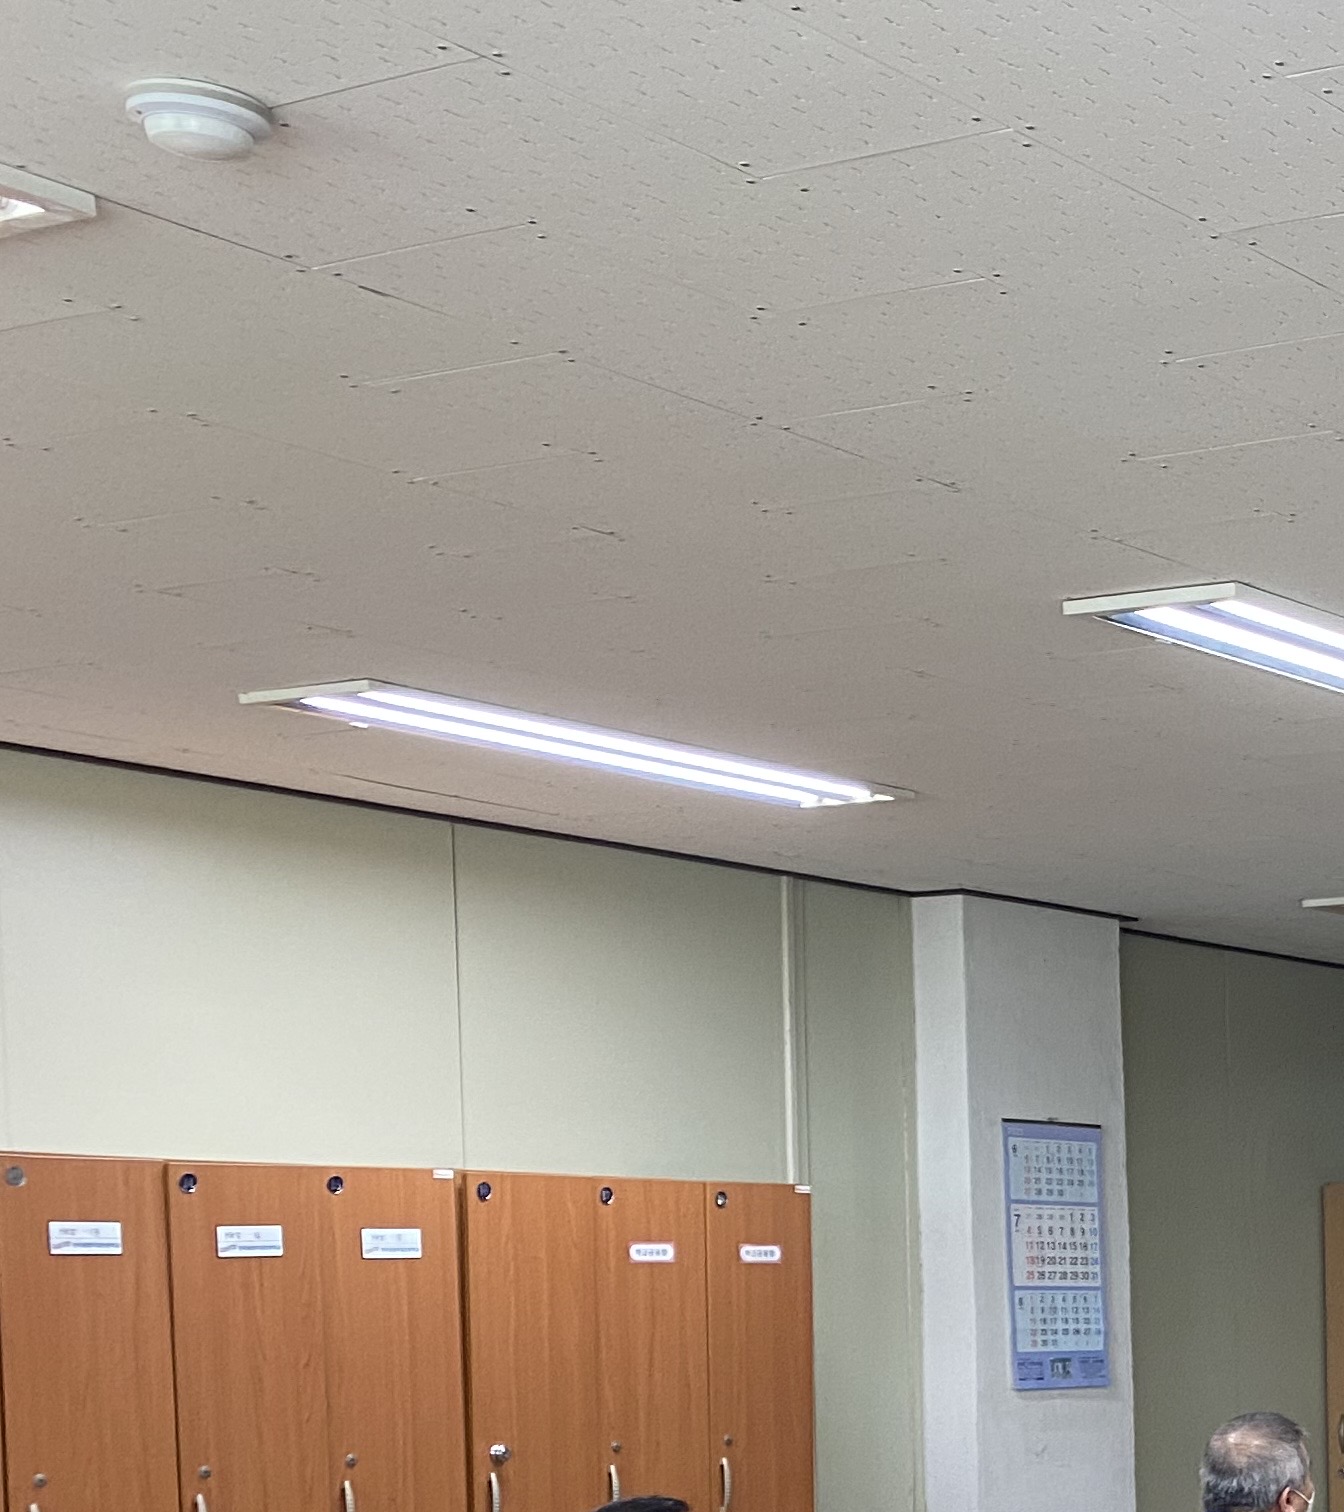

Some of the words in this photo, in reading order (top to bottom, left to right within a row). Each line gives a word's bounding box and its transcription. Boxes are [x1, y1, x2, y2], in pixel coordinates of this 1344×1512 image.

[1014, 1214, 1020, 1227] 7
[1070, 1213, 1073, 1221] 1
[1080, 1213, 1084, 1222] 2
[1048, 1226, 1053, 1235] 6
[1058, 1227, 1064, 1235] 7
[1036, 1241, 1044, 1250] 12
[1047, 1242, 1055, 1250] 13
[1058, 1242, 1067, 1250] 14
[1069, 1242, 1077, 1250] 15
[1079, 1242, 1088, 1251] 16
[1036, 1256, 1045, 1264] 19
[1047, 1256, 1056, 1265] 20
[1058, 1256, 1066, 1265] 21
[1069, 1257, 1078, 1265] 22
[1079, 1257, 1088, 1265] 23
[1037, 1271, 1046, 1280] 26
[1047, 1271, 1057, 1280] 27
[1058, 1271, 1067, 1280] 28
[1069, 1271, 1078, 1280] 29
[1080, 1271, 1089, 1280] 30
